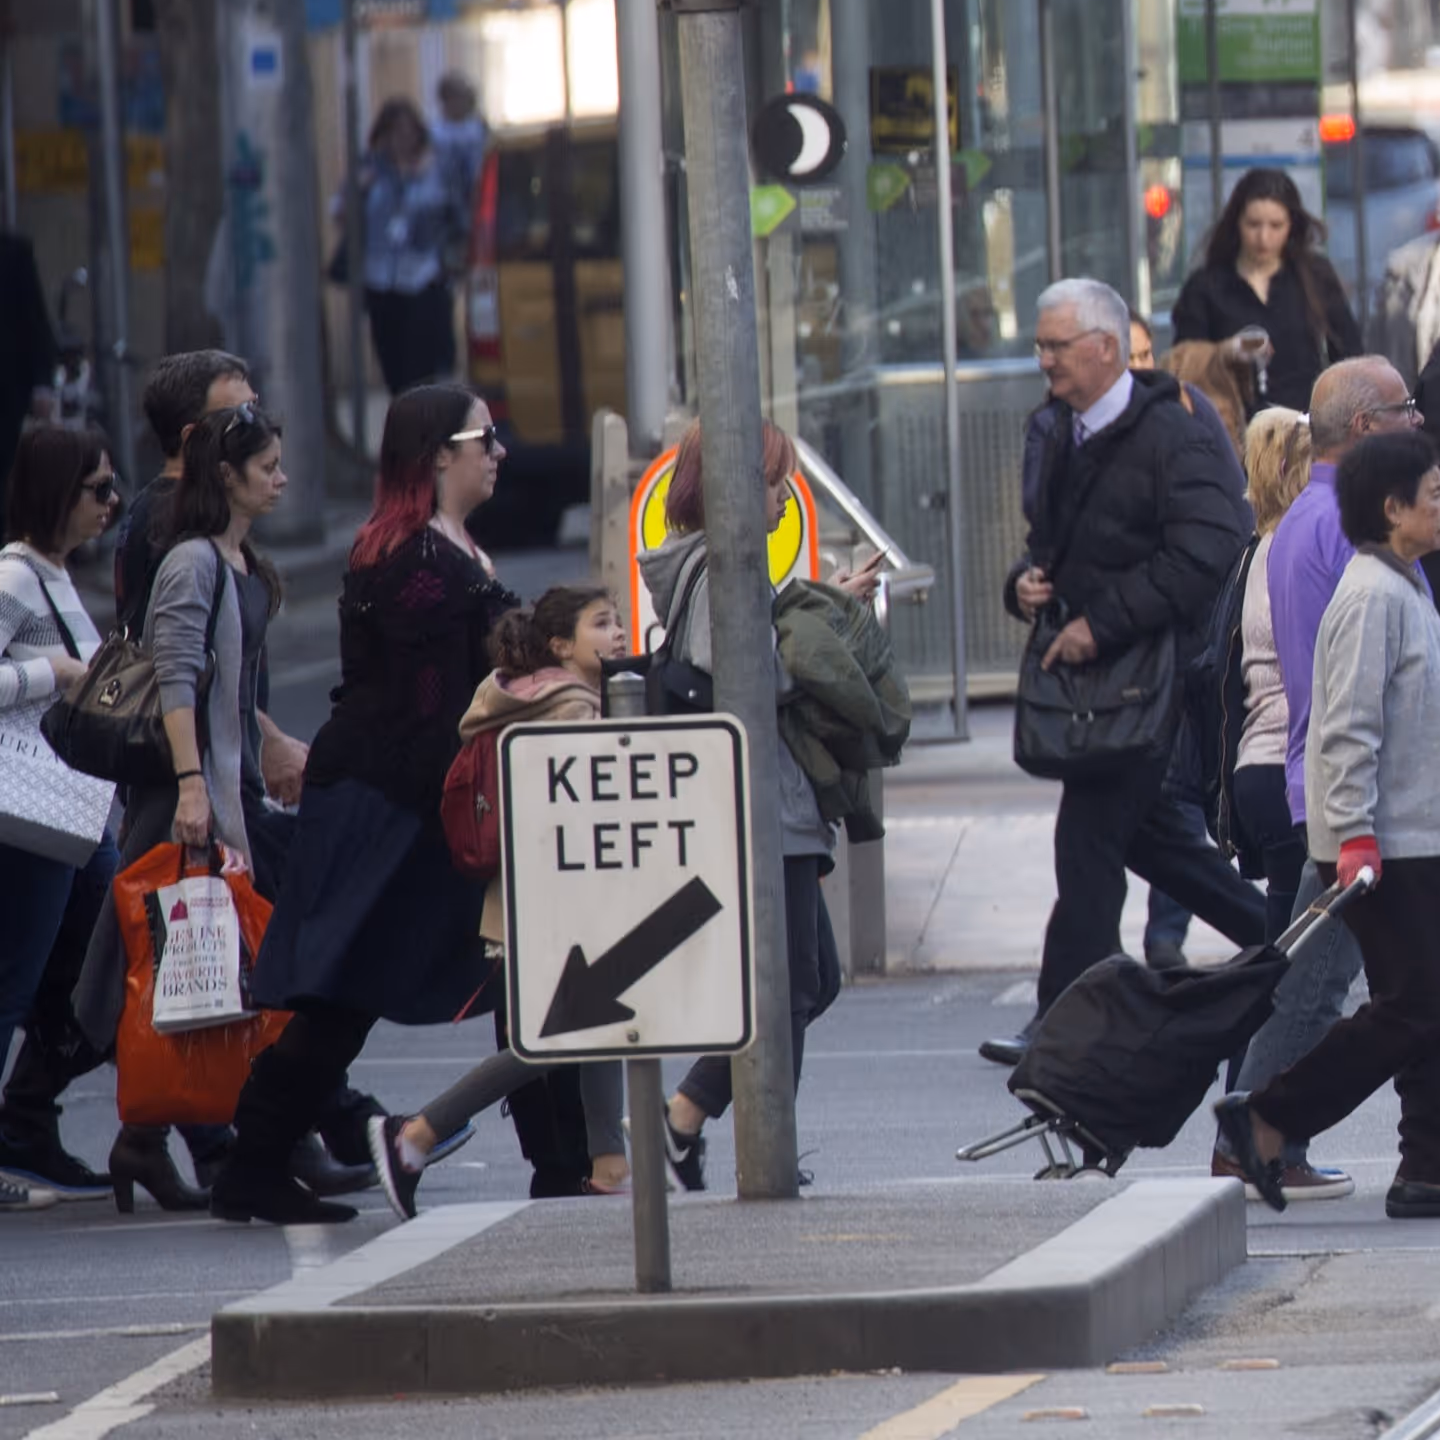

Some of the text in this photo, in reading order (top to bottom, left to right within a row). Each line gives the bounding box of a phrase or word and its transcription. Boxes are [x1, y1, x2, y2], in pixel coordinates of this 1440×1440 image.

[547, 751, 699, 803] KEEP
[556, 820, 696, 871] LEFT
[163, 939, 227, 957] PRODUCTS
[163, 964, 225, 983] FAVOURITE
[162, 978, 228, 998] BRANDS
